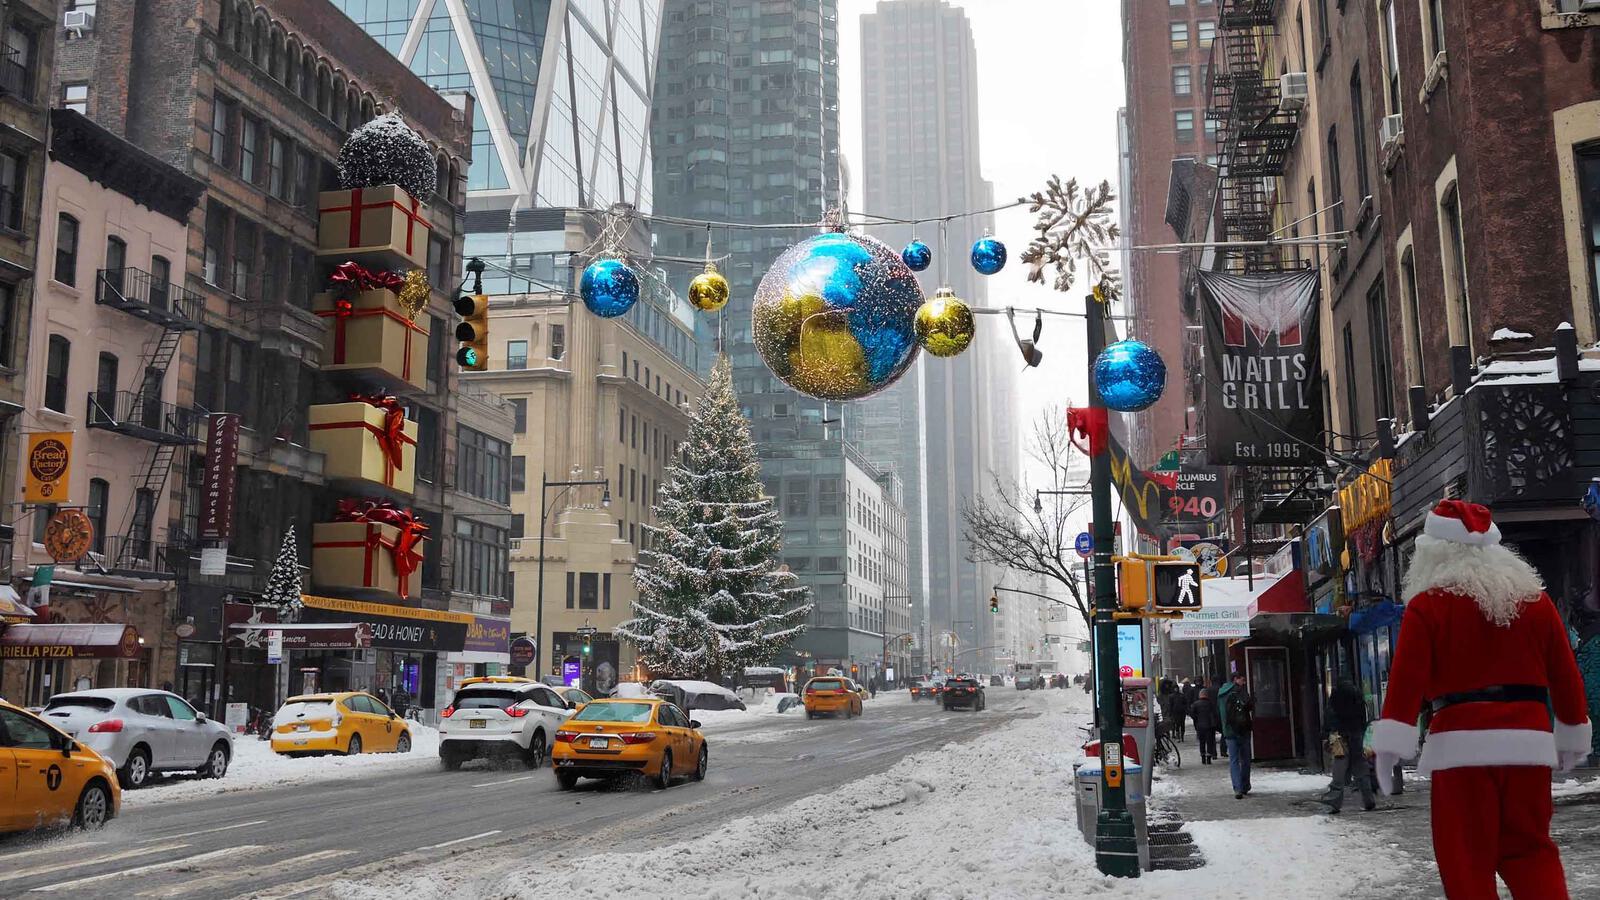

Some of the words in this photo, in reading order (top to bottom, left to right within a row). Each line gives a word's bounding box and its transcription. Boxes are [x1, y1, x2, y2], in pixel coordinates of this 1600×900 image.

[1222, 353, 1306, 382] MATTS
[1223, 381, 1309, 410] GRILL
[33, 450, 66, 460] Bread
[1235, 442, 1262, 458] Est.
[1267, 443, 1300, 458] 1995
[32, 460, 65, 469] Factory
[42, 487, 52, 495] 56
[1168, 496, 1217, 518] 940
[1183, 611, 1219, 620] ourmet
[1221, 610, 1240, 619] Grill
[367, 623, 388, 639] EAD
[388, 626, 395, 640] &
[395, 626, 425, 642] HONEY
[0, 646, 40, 657] RIELLA
[42, 646, 74, 657] PIZZA
